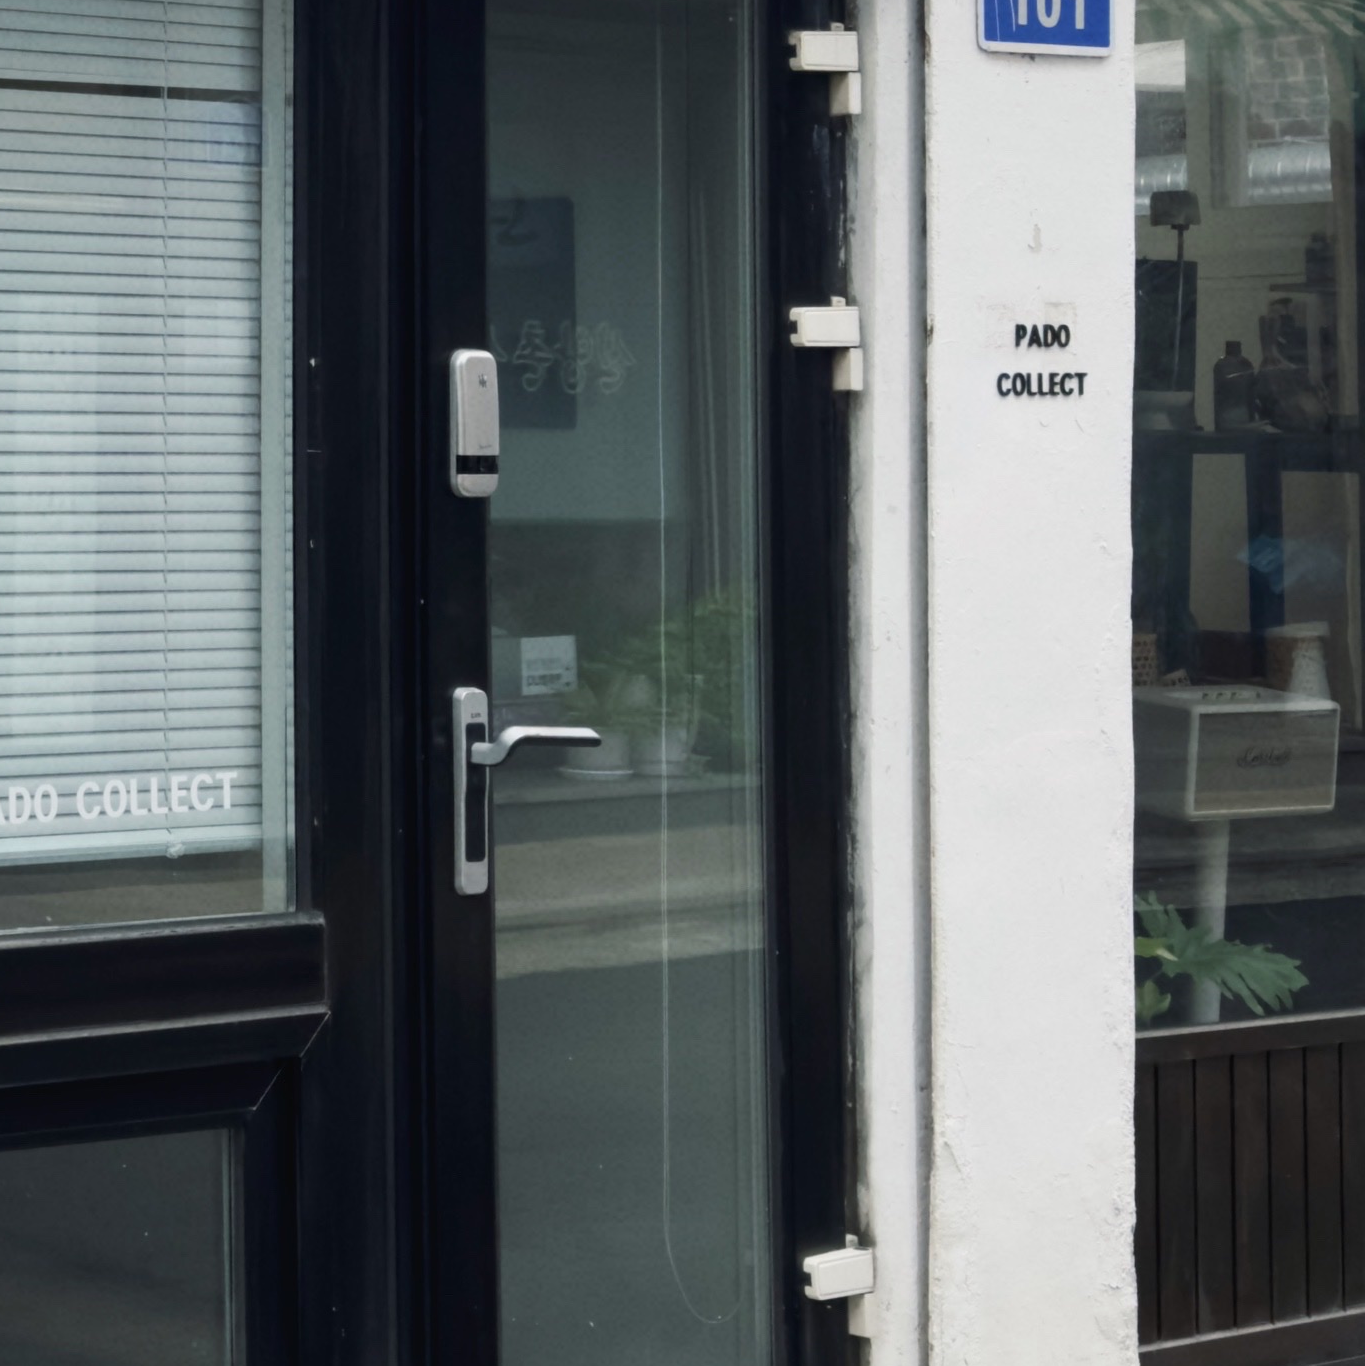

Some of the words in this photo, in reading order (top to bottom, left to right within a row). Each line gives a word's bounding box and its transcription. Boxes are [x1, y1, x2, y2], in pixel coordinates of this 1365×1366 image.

[1014, 323, 1071, 349] PADO
[996, 372, 1088, 397] COLLECT
[75, 771, 238, 821] COLLECT
